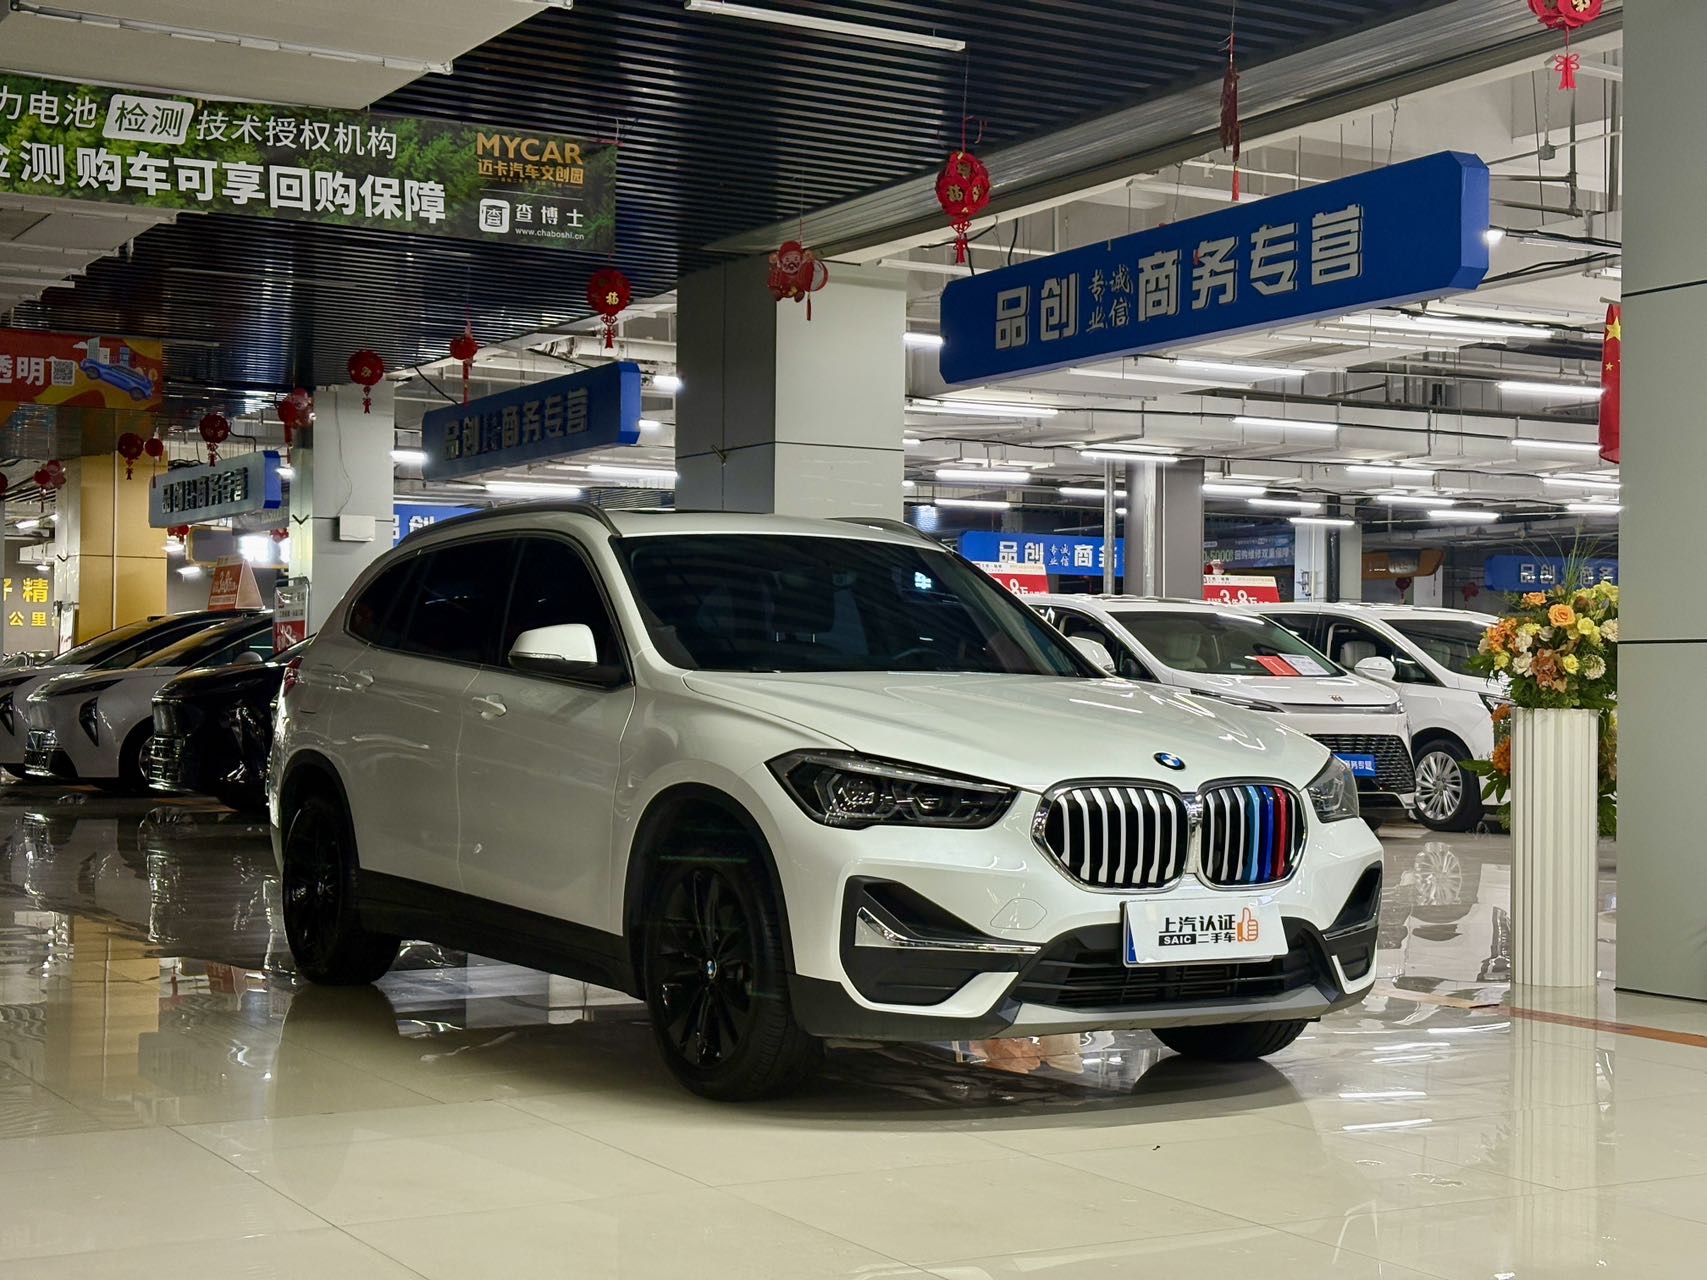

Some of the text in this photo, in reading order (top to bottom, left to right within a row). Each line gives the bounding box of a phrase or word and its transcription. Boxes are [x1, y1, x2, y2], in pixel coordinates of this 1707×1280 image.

[114, 101, 185, 138] 检测
[196, 110, 397, 159] 技术授权机构
[476, 132, 583, 165] MYCAR
[0, 140, 446, 224] 测购车可享回购保障
[478, 159, 584, 184] 迈卡汽车文创园
[515, 203, 584, 228] 查博士
[515, 227, 585, 240] www.chaboshi.cn
[996, 273, 1079, 350] 品创
[1138, 203, 1364, 322] 商务专营
[999, 541, 1044, 564] 品创
[9, 611, 55, 627] 公里
[1158, 914, 1236, 934] 上汽认证
[1163, 935, 1192, 945] SAIC
[1198, 932, 1237, 944] 二手车
